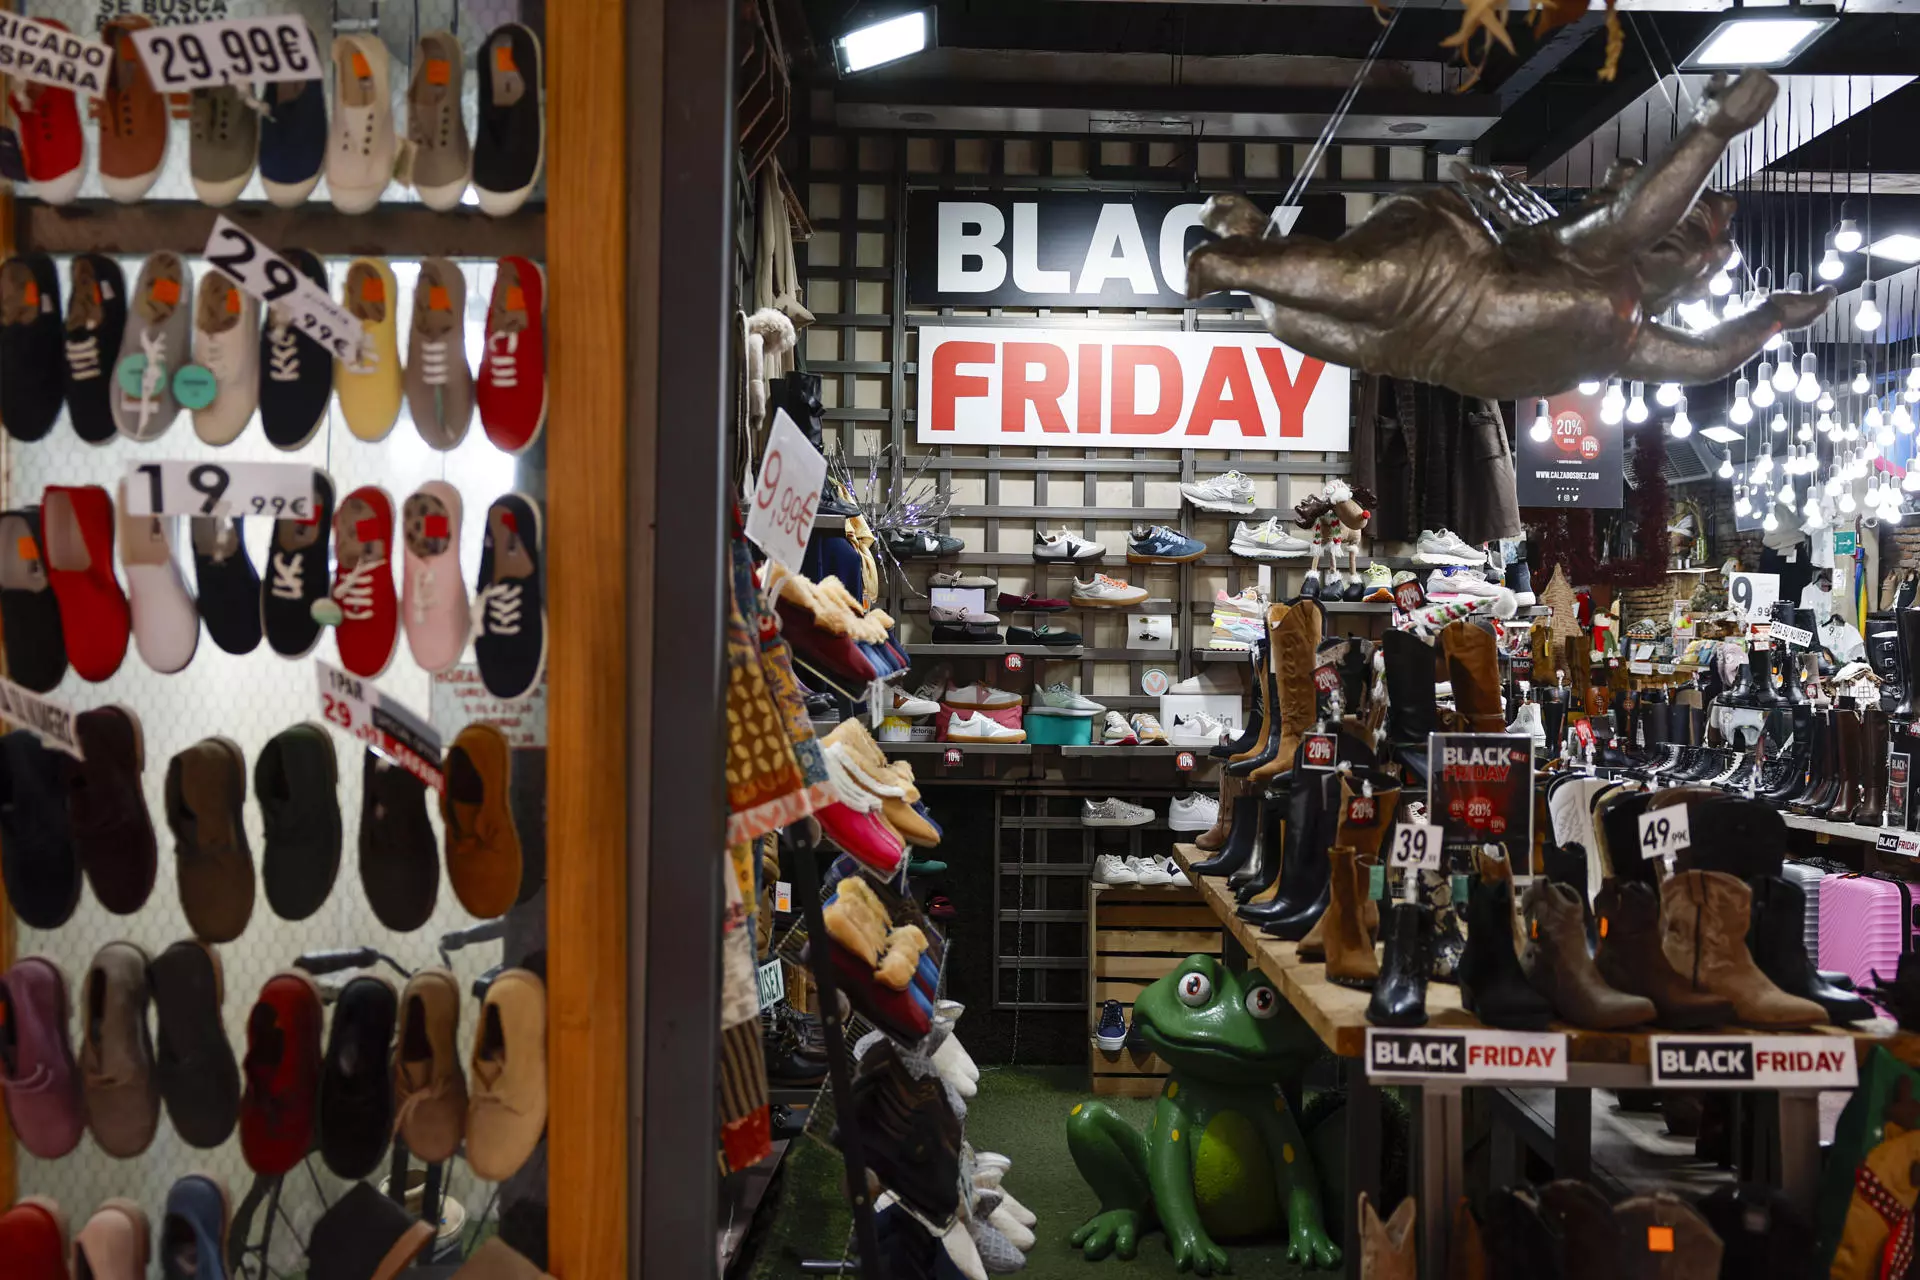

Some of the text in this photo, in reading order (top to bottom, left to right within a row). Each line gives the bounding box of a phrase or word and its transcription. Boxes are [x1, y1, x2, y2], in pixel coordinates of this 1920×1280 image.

[150, 25, 309, 84] 29,99€
[938, 201, 1304, 296] BLAC
[207, 228, 298, 302] 29
[931, 340, 1326, 438] FRIDAY
[1557, 419, 1582, 436] 20%
[136, 463, 230, 514] 19
[1008, 656, 1021, 667] 10%
[948, 752, 960, 762] 10%
[1309, 742, 1331, 759] 20%
[1443, 747, 1512, 766] BLACK
[1180, 756, 1193, 767] 10%
[1443, 765, 1510, 782] FRIDAY
[1352, 802, 1375, 820] 20%
[1468, 803, 1492, 817] 20%
[1643, 817, 1670, 850] 49
[1397, 829, 1428, 863] 39
[1879, 836, 1919, 852] BLACK FRIDAY
[1375, 1041, 1556, 1067] BLACK FRIDAY
[1661, 1049, 1845, 1073] BLACK FRIDAY
